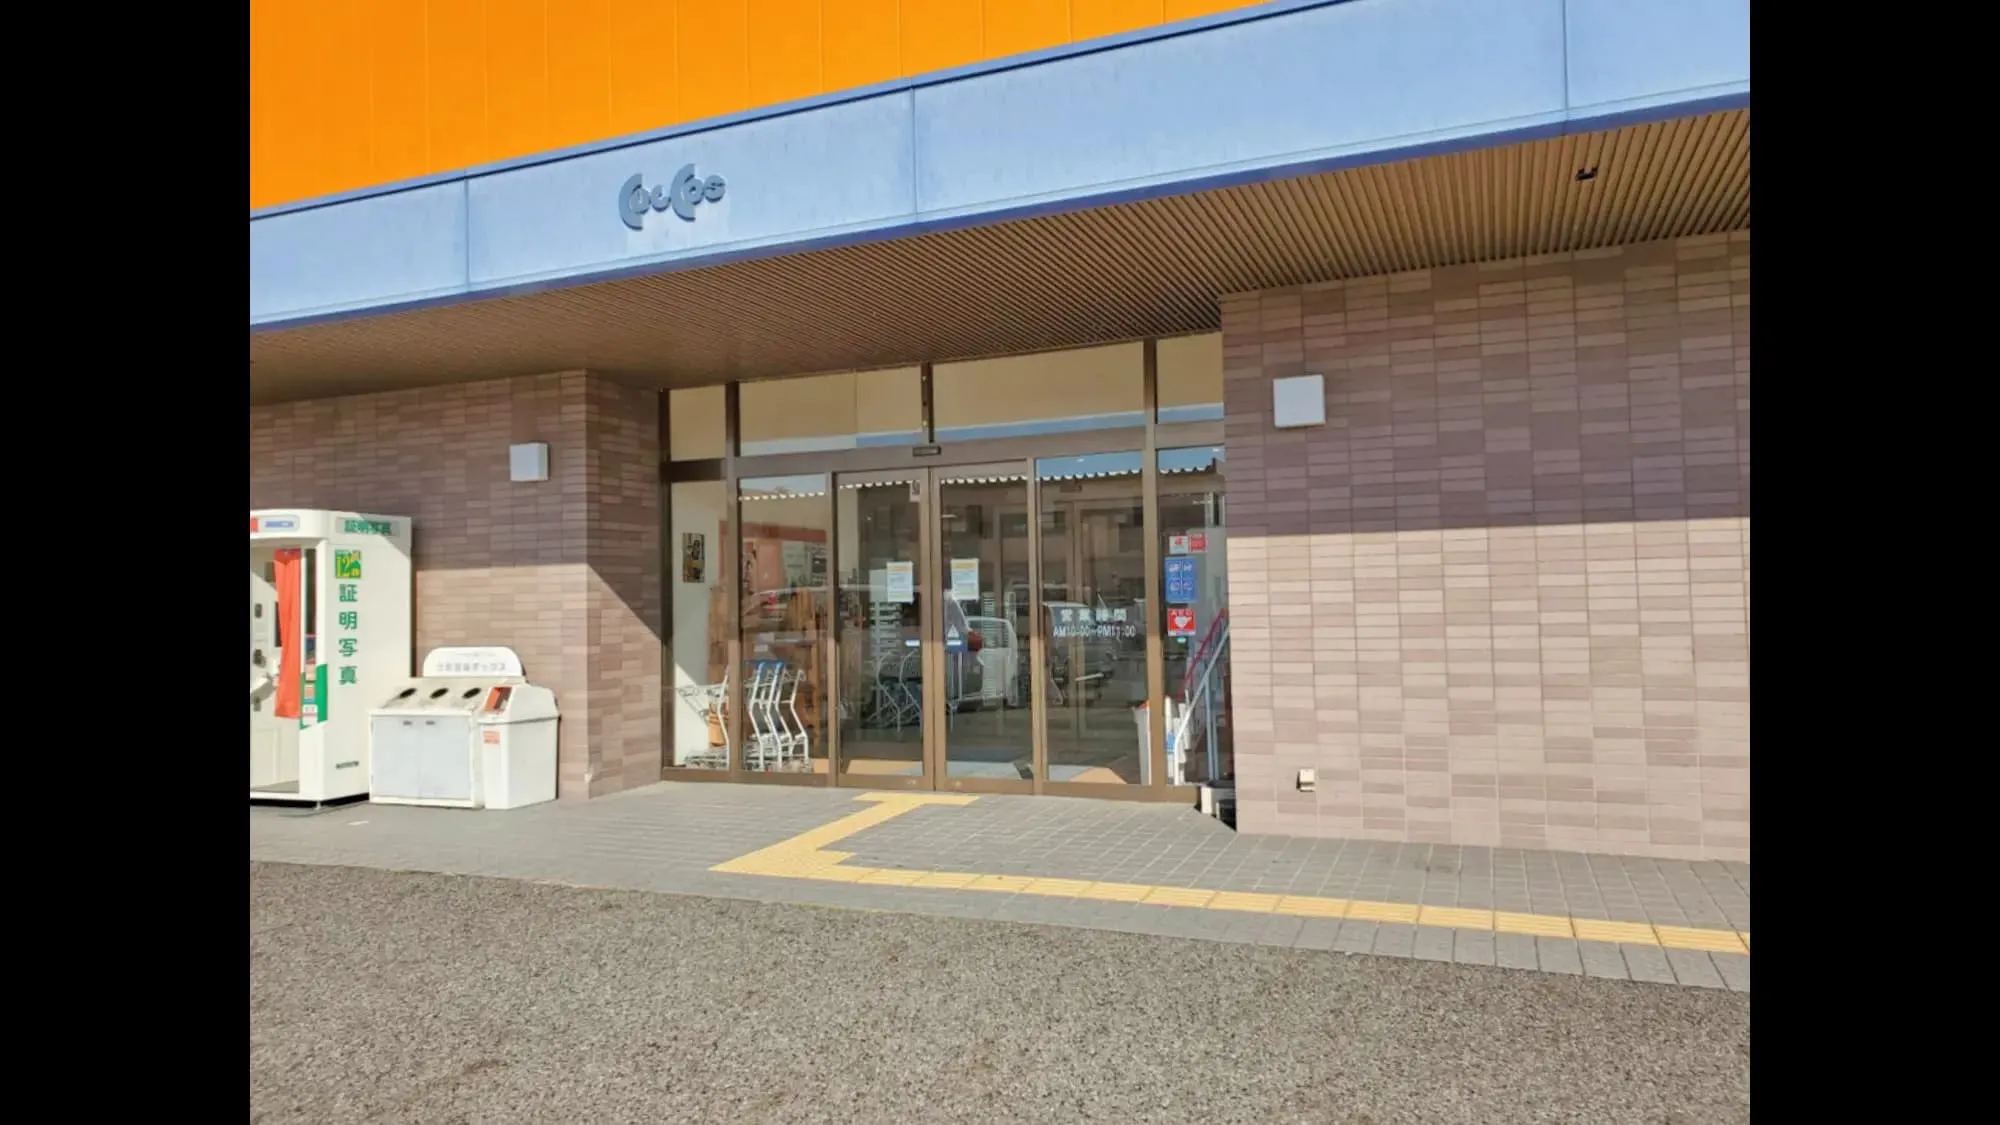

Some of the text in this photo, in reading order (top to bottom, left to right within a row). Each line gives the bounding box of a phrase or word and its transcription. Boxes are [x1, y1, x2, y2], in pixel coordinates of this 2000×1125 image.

[338, 583, 359, 686] 証明写真
[1060, 608, 1127, 622] 営業時間
